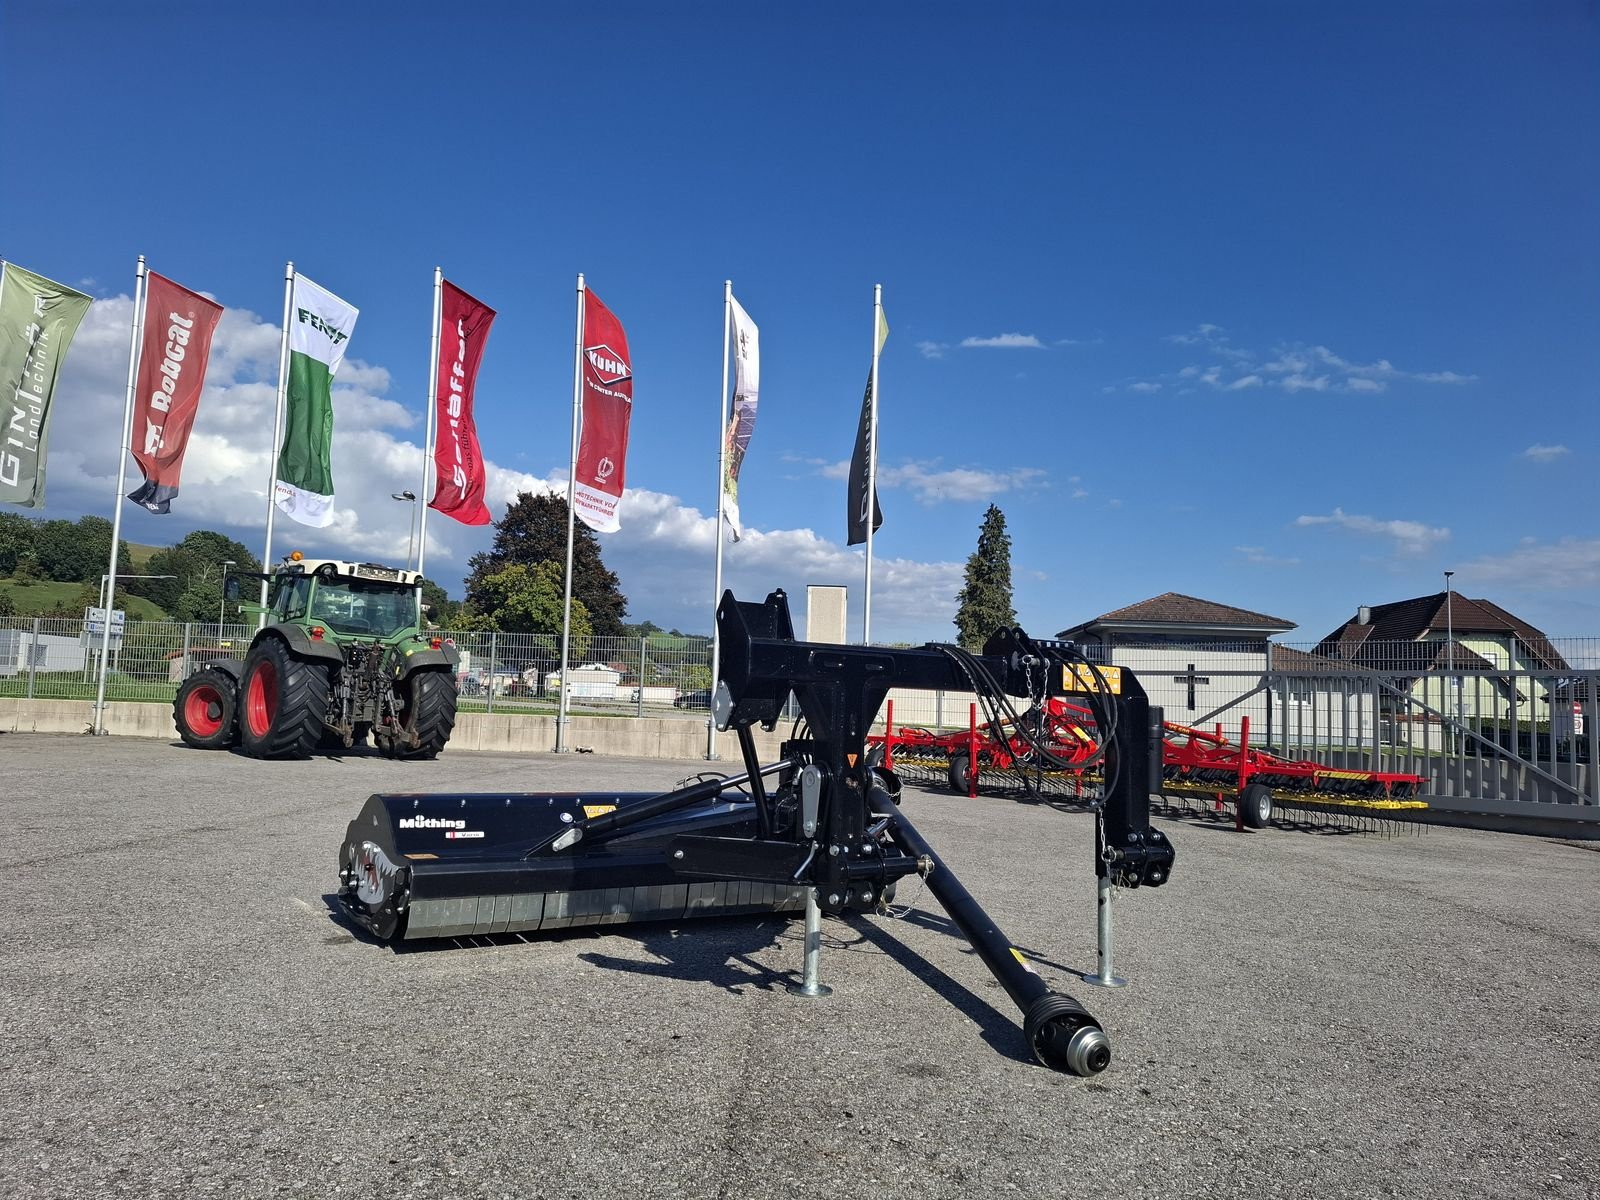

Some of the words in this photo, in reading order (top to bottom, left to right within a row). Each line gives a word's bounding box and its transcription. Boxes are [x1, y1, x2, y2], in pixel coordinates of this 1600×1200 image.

[151, 311, 194, 414] Bobcat
[589, 350, 626, 377] KUHN
[399, 814, 466, 829] Müthing
